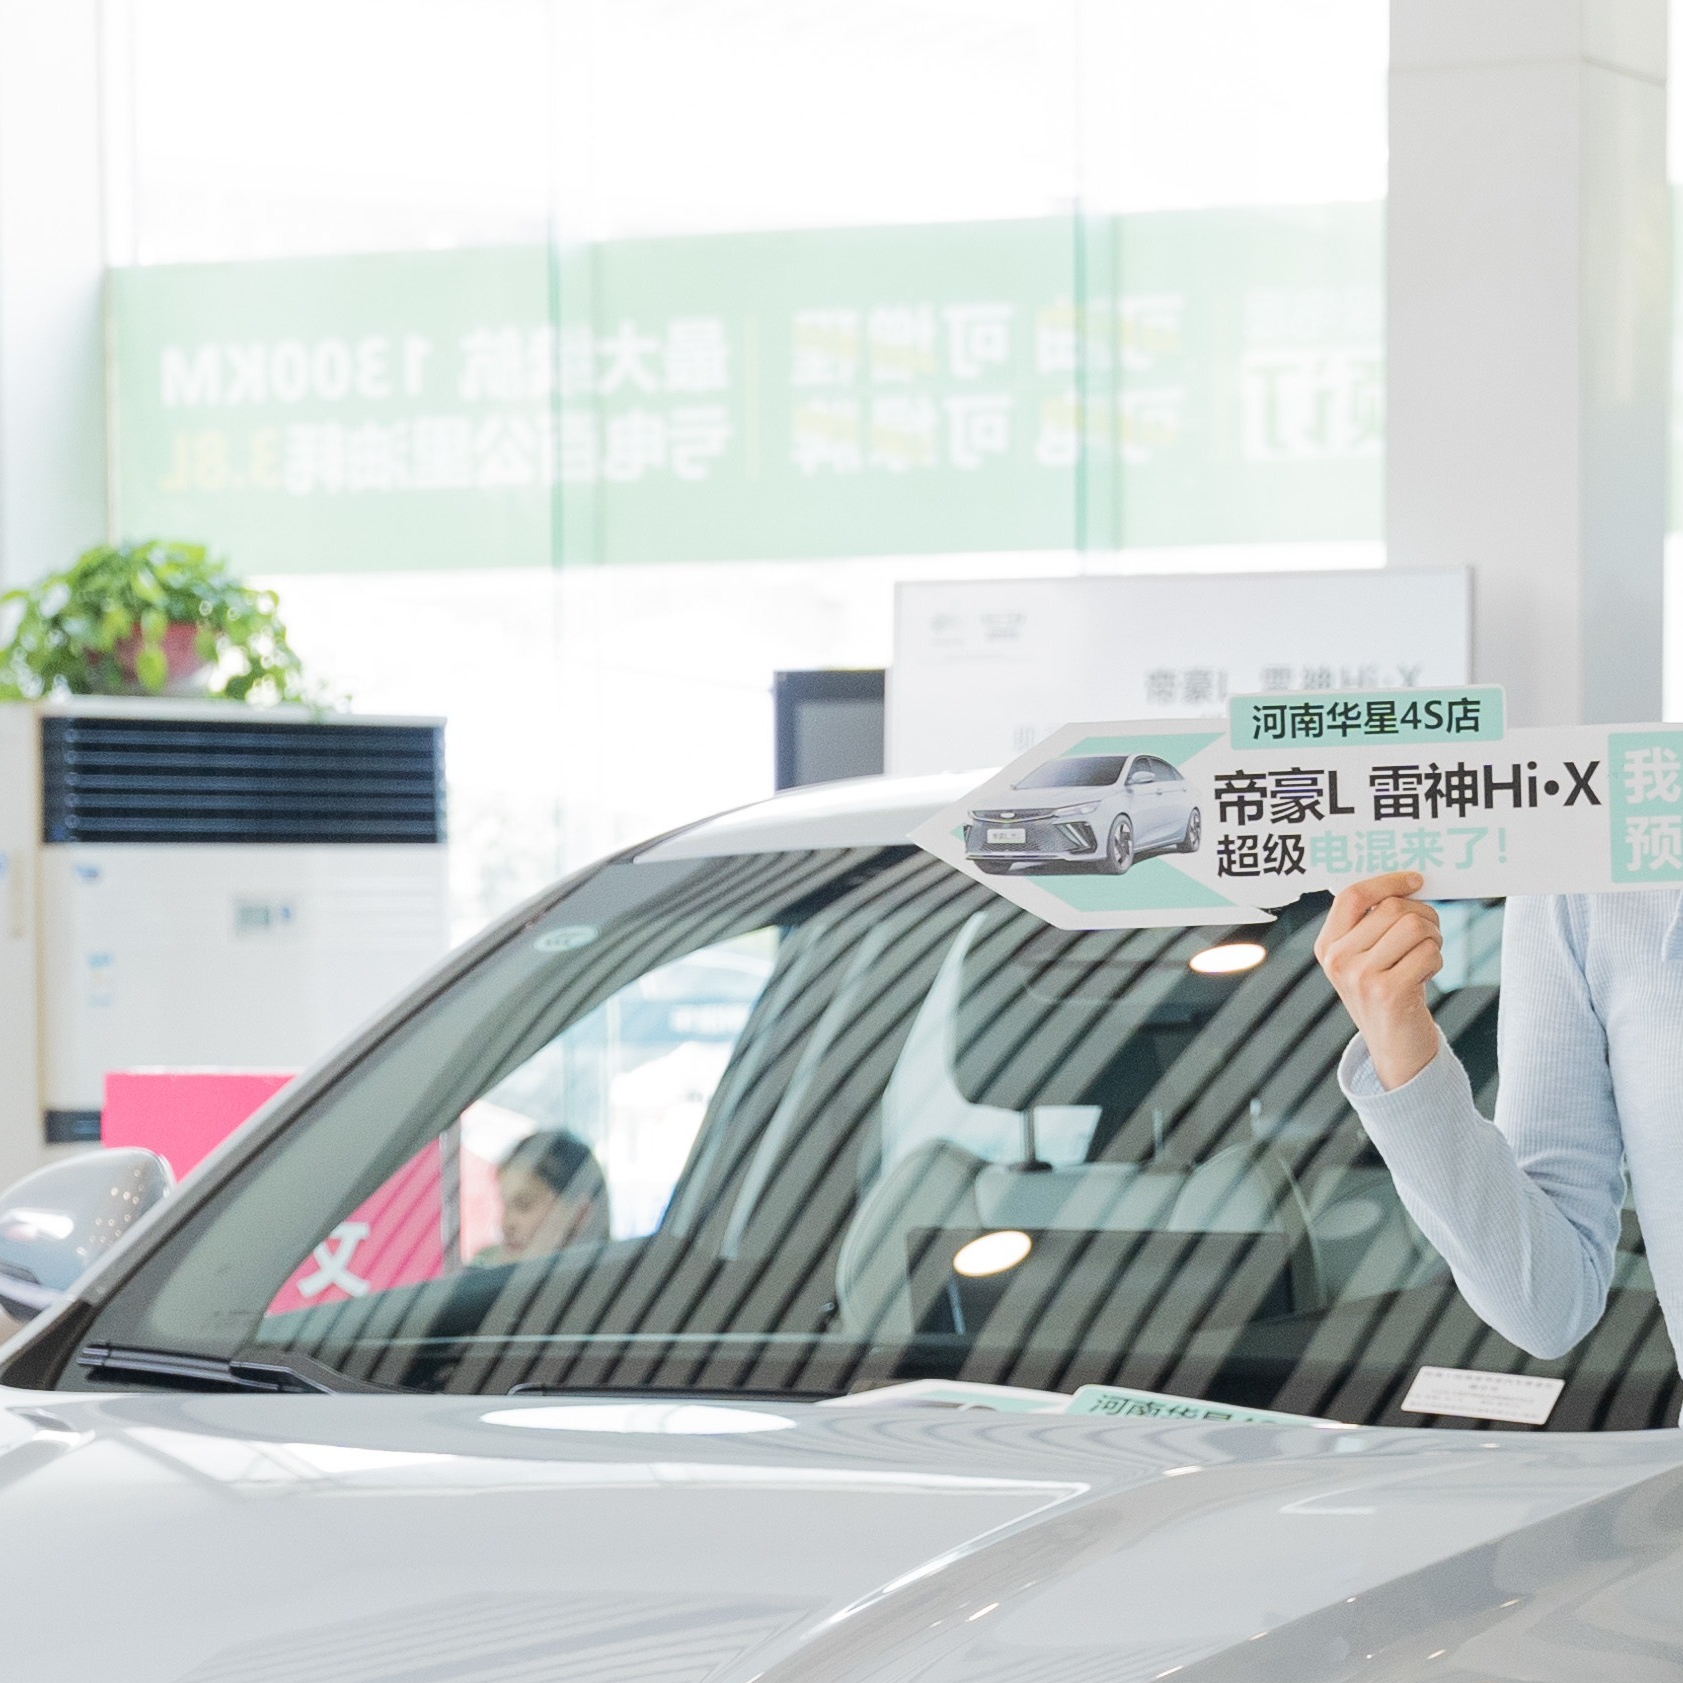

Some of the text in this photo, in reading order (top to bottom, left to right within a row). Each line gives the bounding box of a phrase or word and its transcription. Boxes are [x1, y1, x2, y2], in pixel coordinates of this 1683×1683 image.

[1252, 697, 1481, 740] 河南华星4S店
[1214, 766, 1355, 826] 帝豪L
